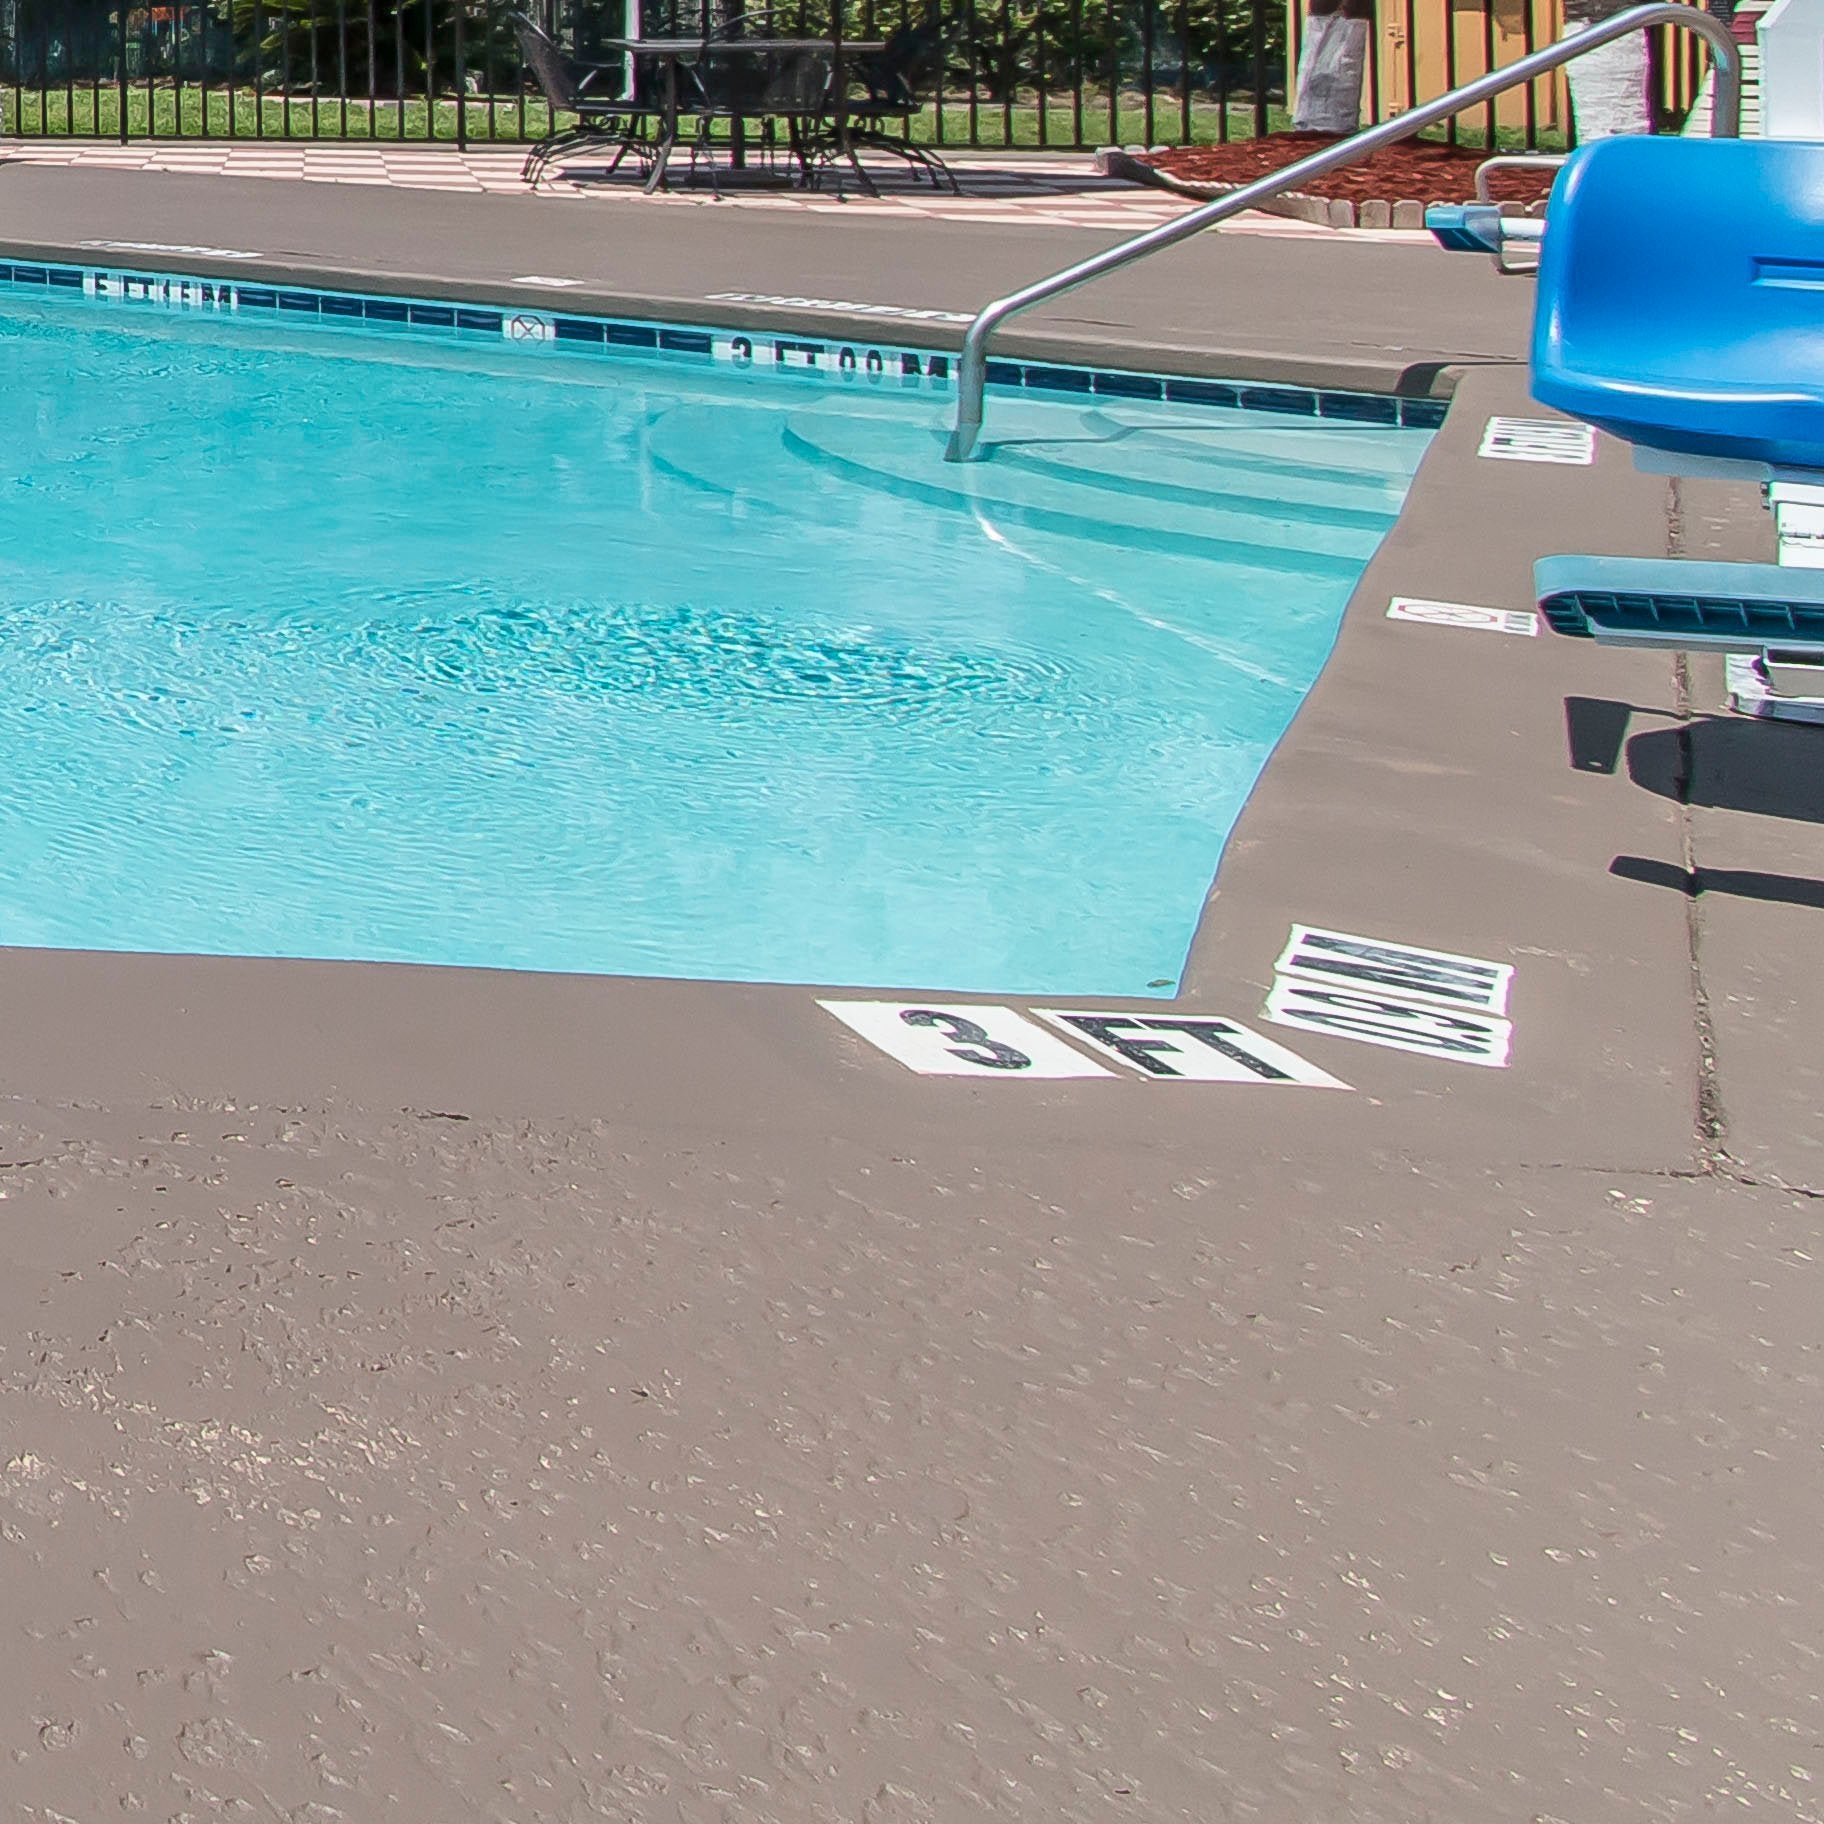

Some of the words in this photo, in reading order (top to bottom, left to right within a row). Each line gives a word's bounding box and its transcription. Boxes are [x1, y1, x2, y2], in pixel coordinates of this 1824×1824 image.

[1289, 933, 1500, 1006] M
[899, 1008, 1032, 1070] 3
[1056, 1014, 1301, 1082] FT
